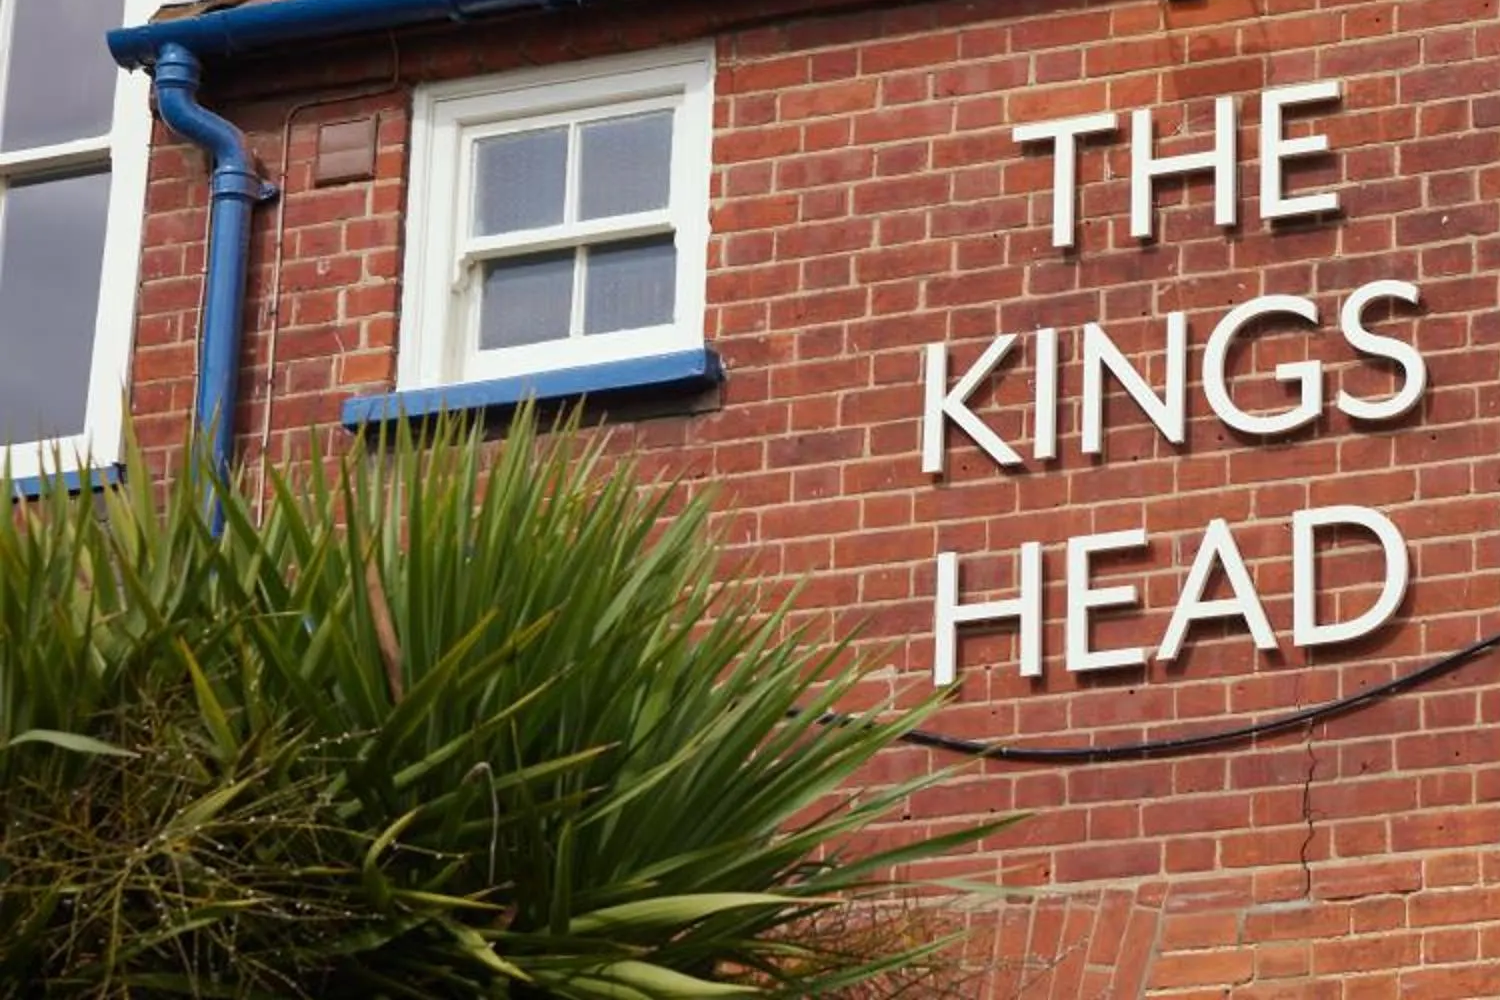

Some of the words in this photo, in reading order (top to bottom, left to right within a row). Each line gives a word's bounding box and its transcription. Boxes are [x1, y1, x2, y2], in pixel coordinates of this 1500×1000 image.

[1011, 80, 1341, 248] THE
[921, 279, 1427, 474] KINGS
[933, 504, 1410, 686] HEAD
